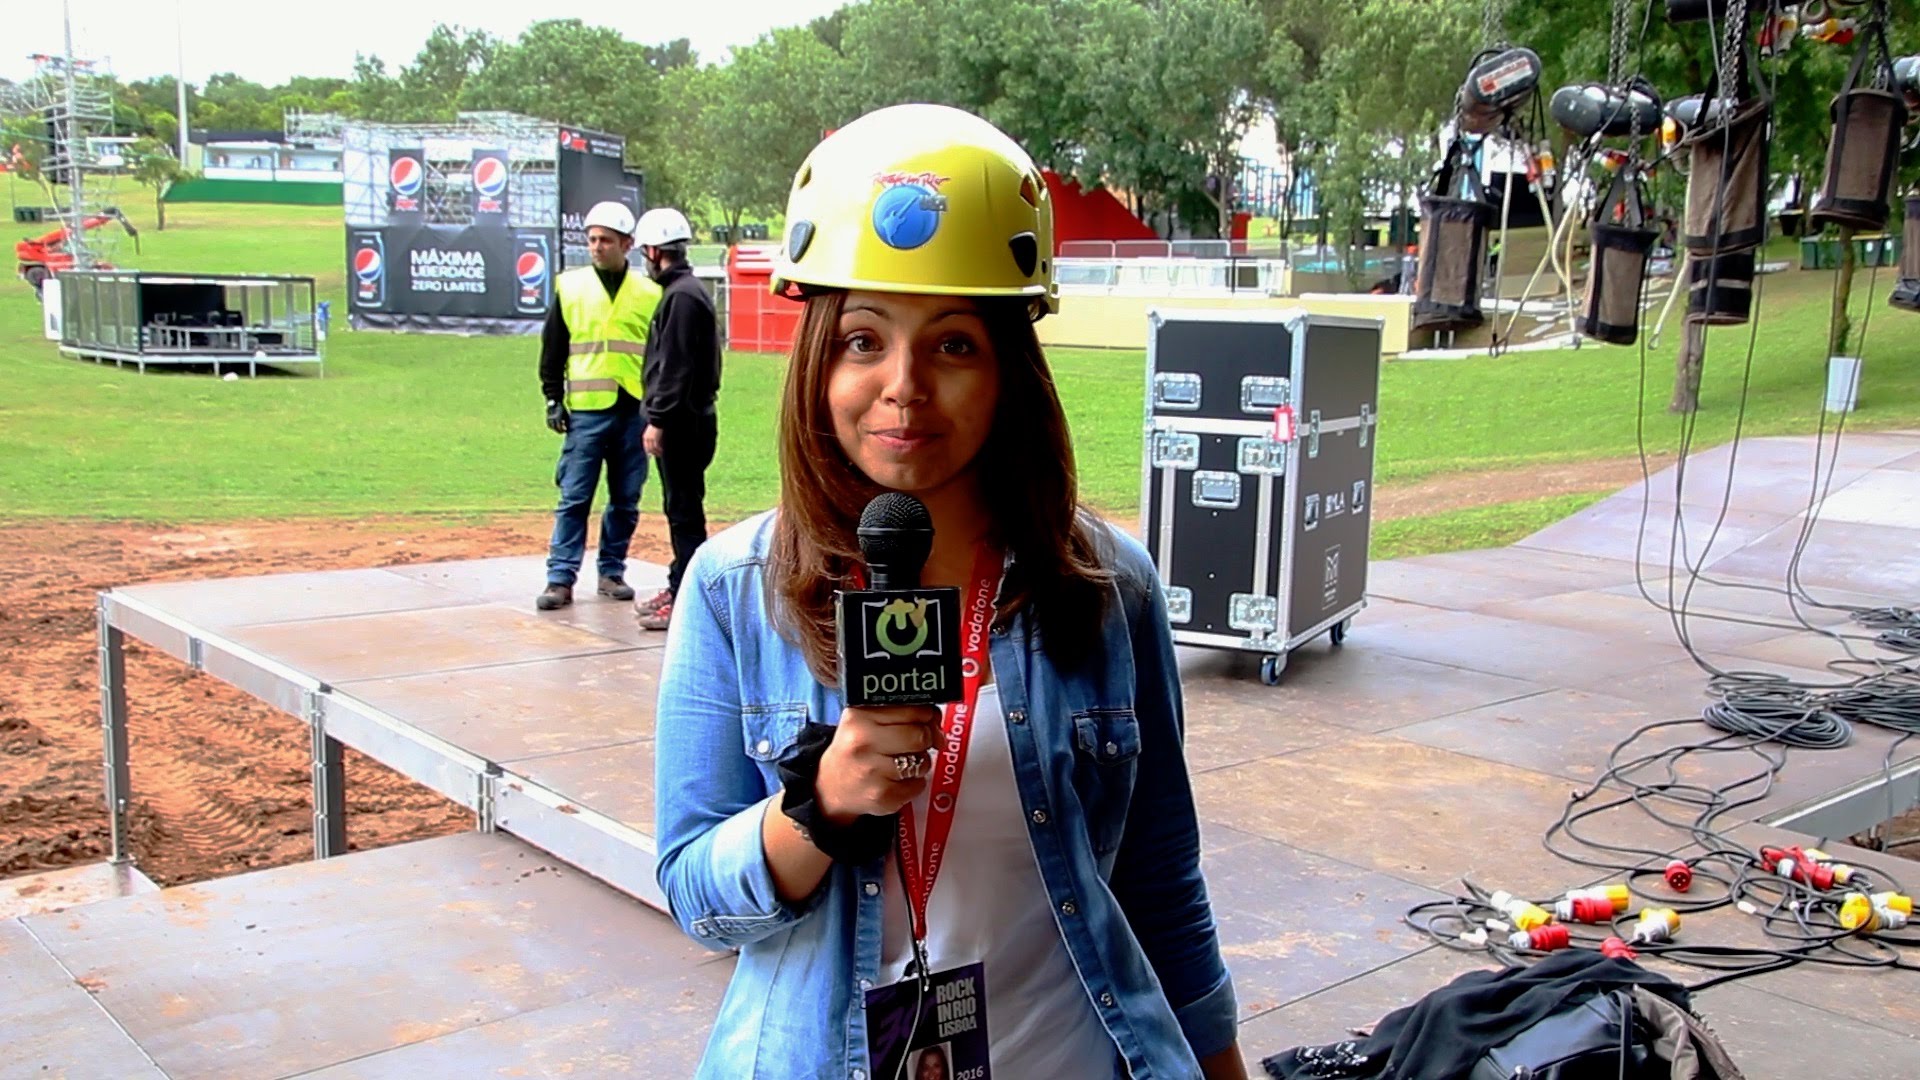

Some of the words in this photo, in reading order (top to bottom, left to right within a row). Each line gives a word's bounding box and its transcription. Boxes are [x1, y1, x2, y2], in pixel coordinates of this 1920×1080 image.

[411, 248, 485, 266] MÁXIMA
[411, 265, 486, 280] LIBERDADE
[411, 279, 442, 292] ZERO
[443, 281, 487, 293] LIMITES
[966, 578, 991, 653] vodafone
[863, 665, 946, 700] portal
[942, 703, 968, 785] vodafone
[936, 977, 976, 1004] ROCK
[937, 1002, 953, 1023] IN
[952, 996, 977, 1019] RIO
[938, 1015, 978, 1038] LISBOA
[957, 1066, 984, 1080] 2016
